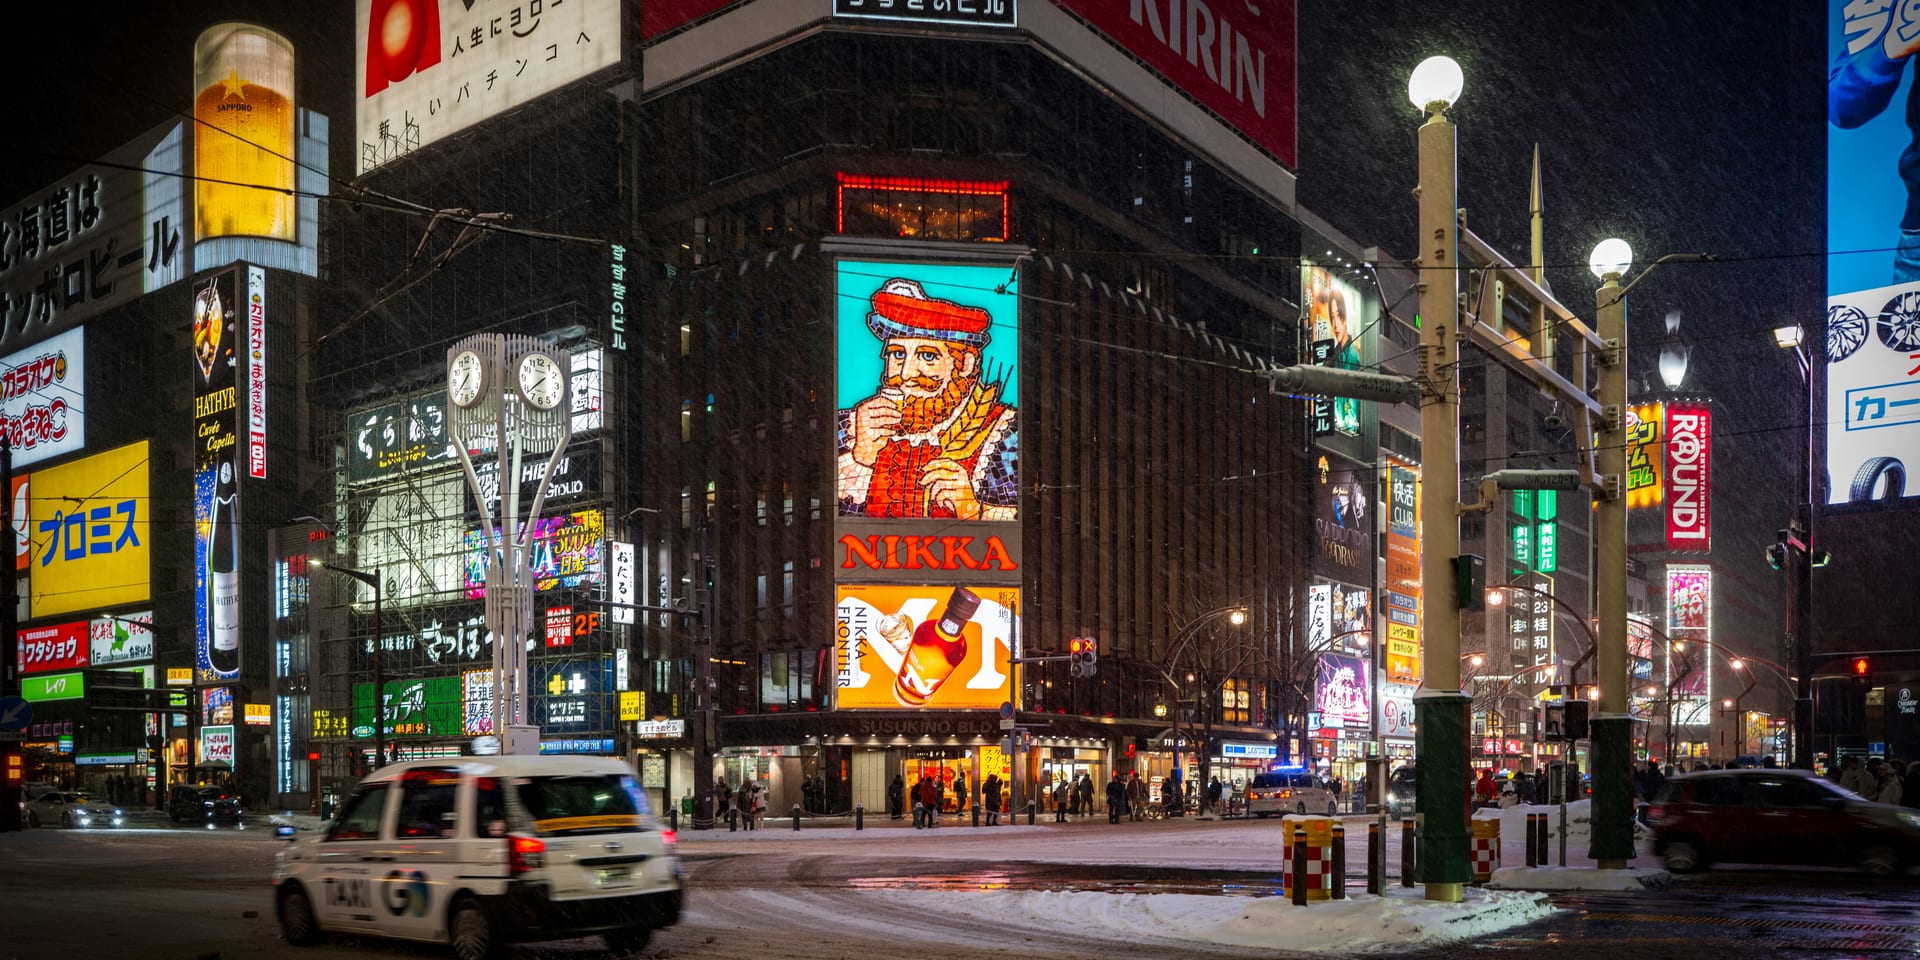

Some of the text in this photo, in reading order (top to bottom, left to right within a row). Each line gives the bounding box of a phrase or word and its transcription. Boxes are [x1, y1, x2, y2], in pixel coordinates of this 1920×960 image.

[378, 31, 592, 141] 新しいパチンコへ
[216, 103, 253, 113] SAPPORO
[250, 302, 264, 350] カラオケ
[3, 356, 57, 400] カラオケ
[251, 362, 264, 428] まねきねこ
[207, 434, 236, 453] Capella
[522, 457, 570, 484] HIBKI
[1672, 414, 1706, 540] ROUND1
[545, 480, 583, 499] Group
[1393, 478, 1415, 507] 快活
[1393, 506, 1415, 527] CLUB
[40, 499, 141, 568] プロミス
[1540, 522, 1554, 570] 美和ビル
[839, 534, 1019, 571] NIKKA
[575, 611, 600, 636] 2F
[854, 606, 868, 661] NIKKA
[25, 635, 78, 664] ワタショウ
[91, 647, 102, 664] 1F
[838, 606, 851, 688] FRONTIER
[45, 678, 67, 695] レイク
[859, 719, 997, 734] SUSUKINO BLD.
